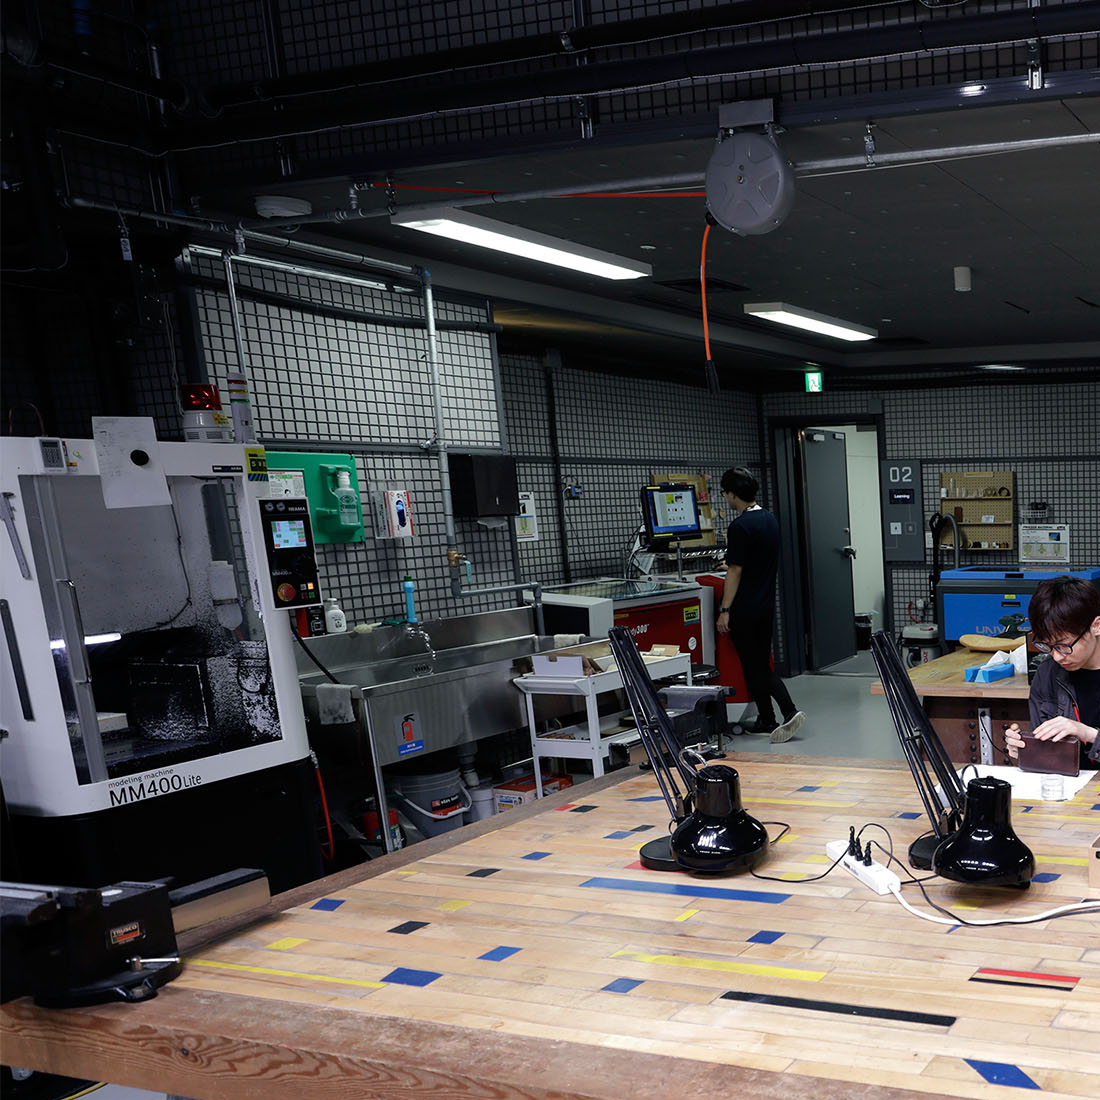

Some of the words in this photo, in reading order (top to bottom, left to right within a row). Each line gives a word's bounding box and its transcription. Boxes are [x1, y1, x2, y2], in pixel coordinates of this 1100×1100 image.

[889, 466, 912, 482] 02
[108, 776, 142, 789] modeling
[143, 767, 174, 780] machine
[109, 774, 182, 807] MM400
[182, 774, 202, 788] Lite
